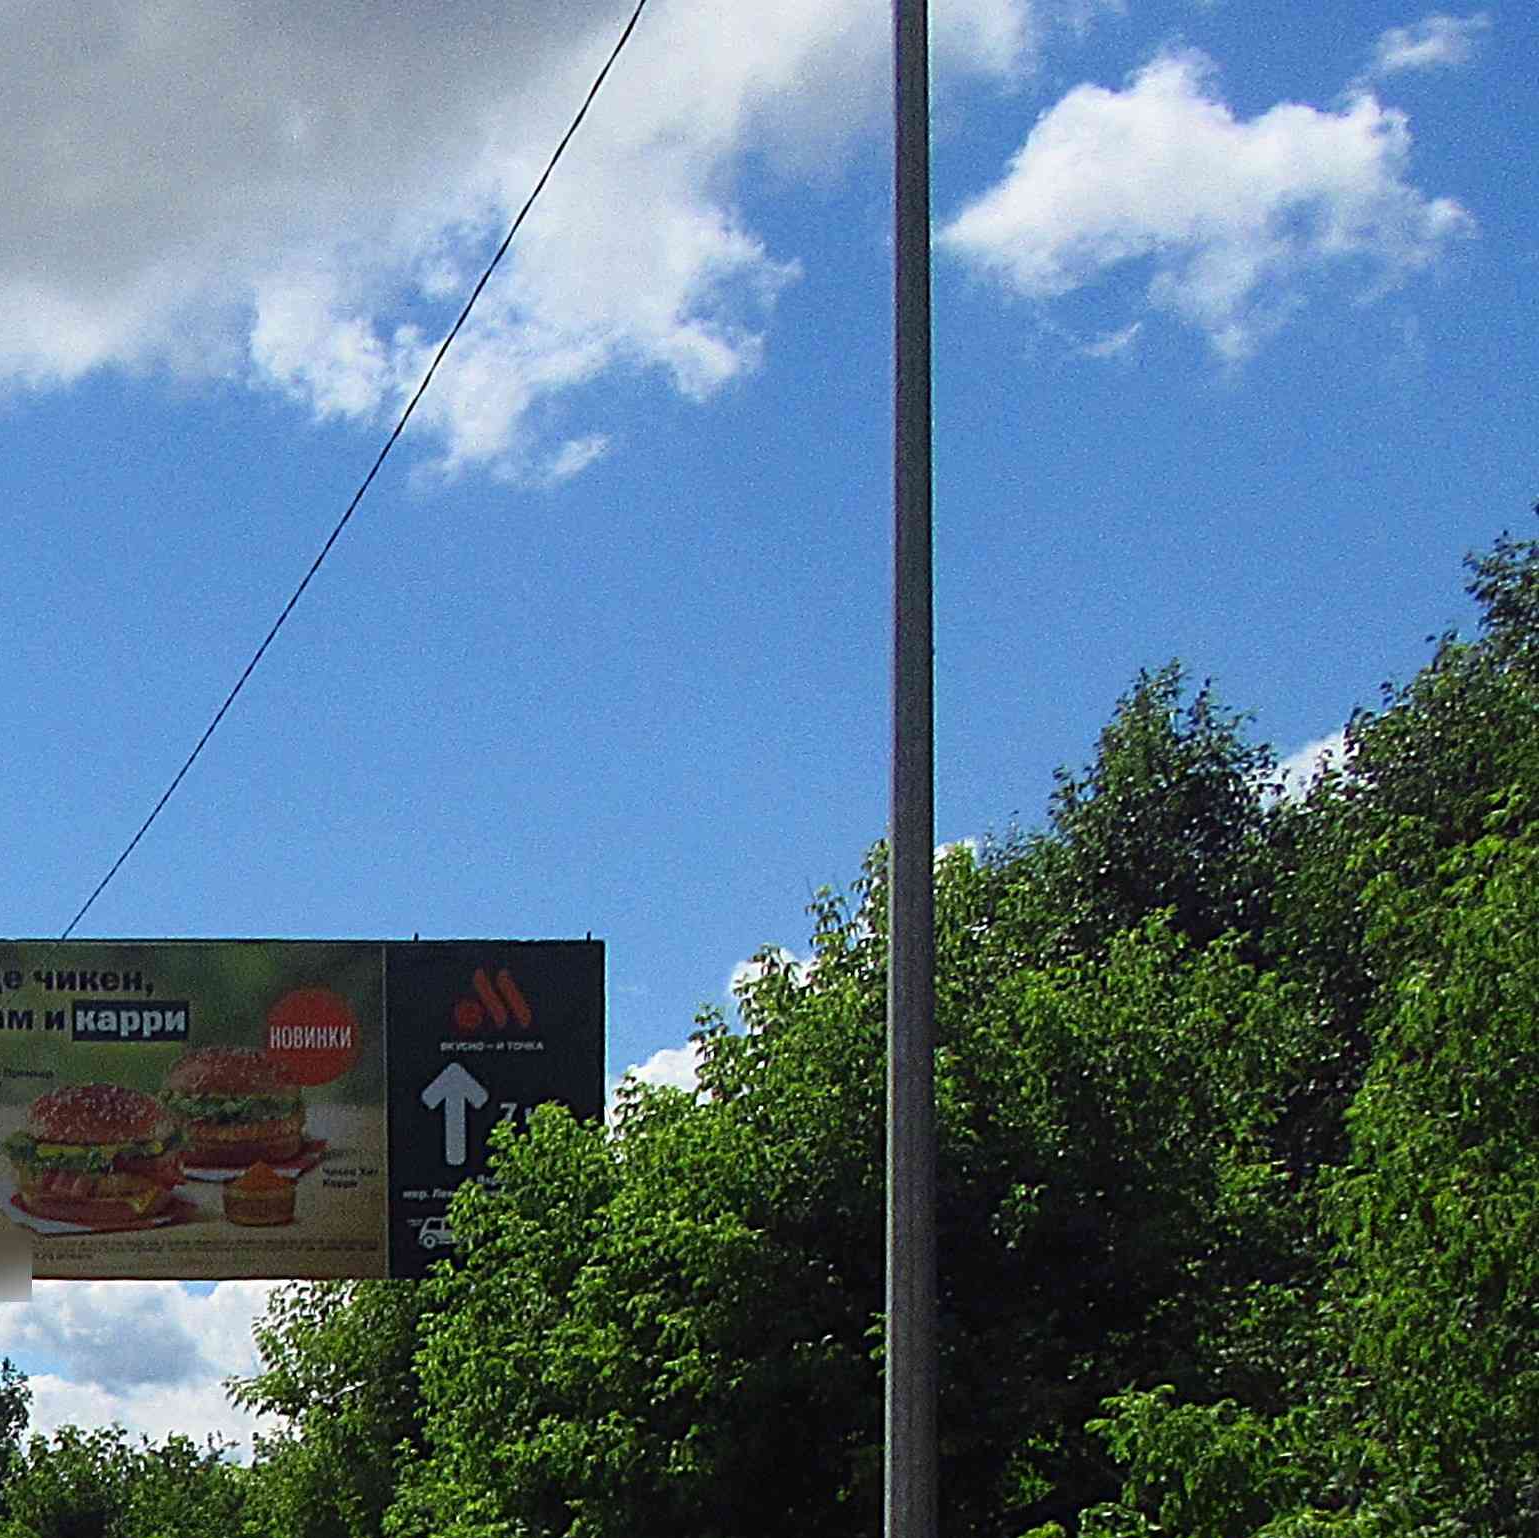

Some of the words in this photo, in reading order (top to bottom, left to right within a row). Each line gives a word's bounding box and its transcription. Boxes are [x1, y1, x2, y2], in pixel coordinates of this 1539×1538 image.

[34, 969, 155, 996] чикен,
[44, 1008, 66, 1031] и
[75, 1009, 186, 1037] карри
[269, 1025, 352, 1049] НОВИНКИ
